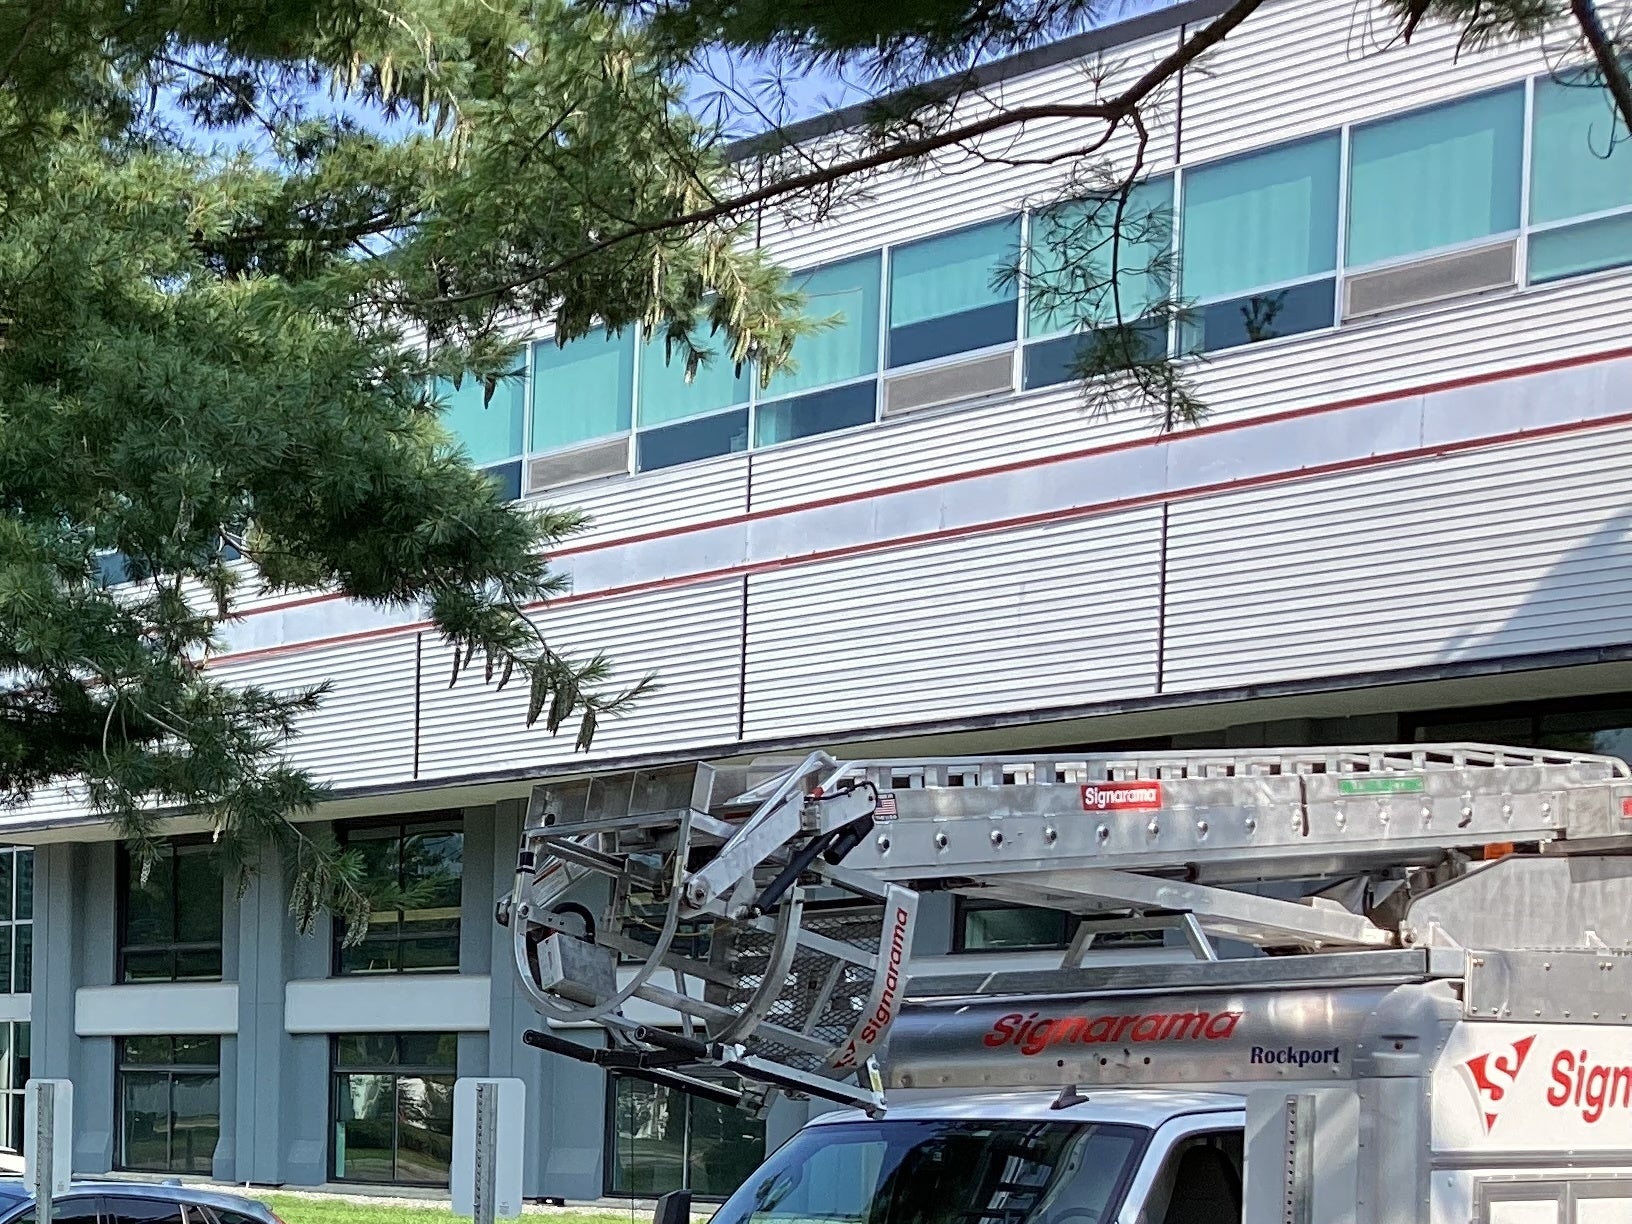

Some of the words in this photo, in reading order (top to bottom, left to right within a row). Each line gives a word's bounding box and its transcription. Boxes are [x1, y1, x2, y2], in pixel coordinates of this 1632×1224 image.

[1085, 786, 1157, 809] Signarama
[861, 906, 909, 1044] Signarama
[983, 1011, 1245, 1056] Signarama
[1250, 1046, 1340, 1066] Rockport
[1547, 1049, 1632, 1124] Sign
